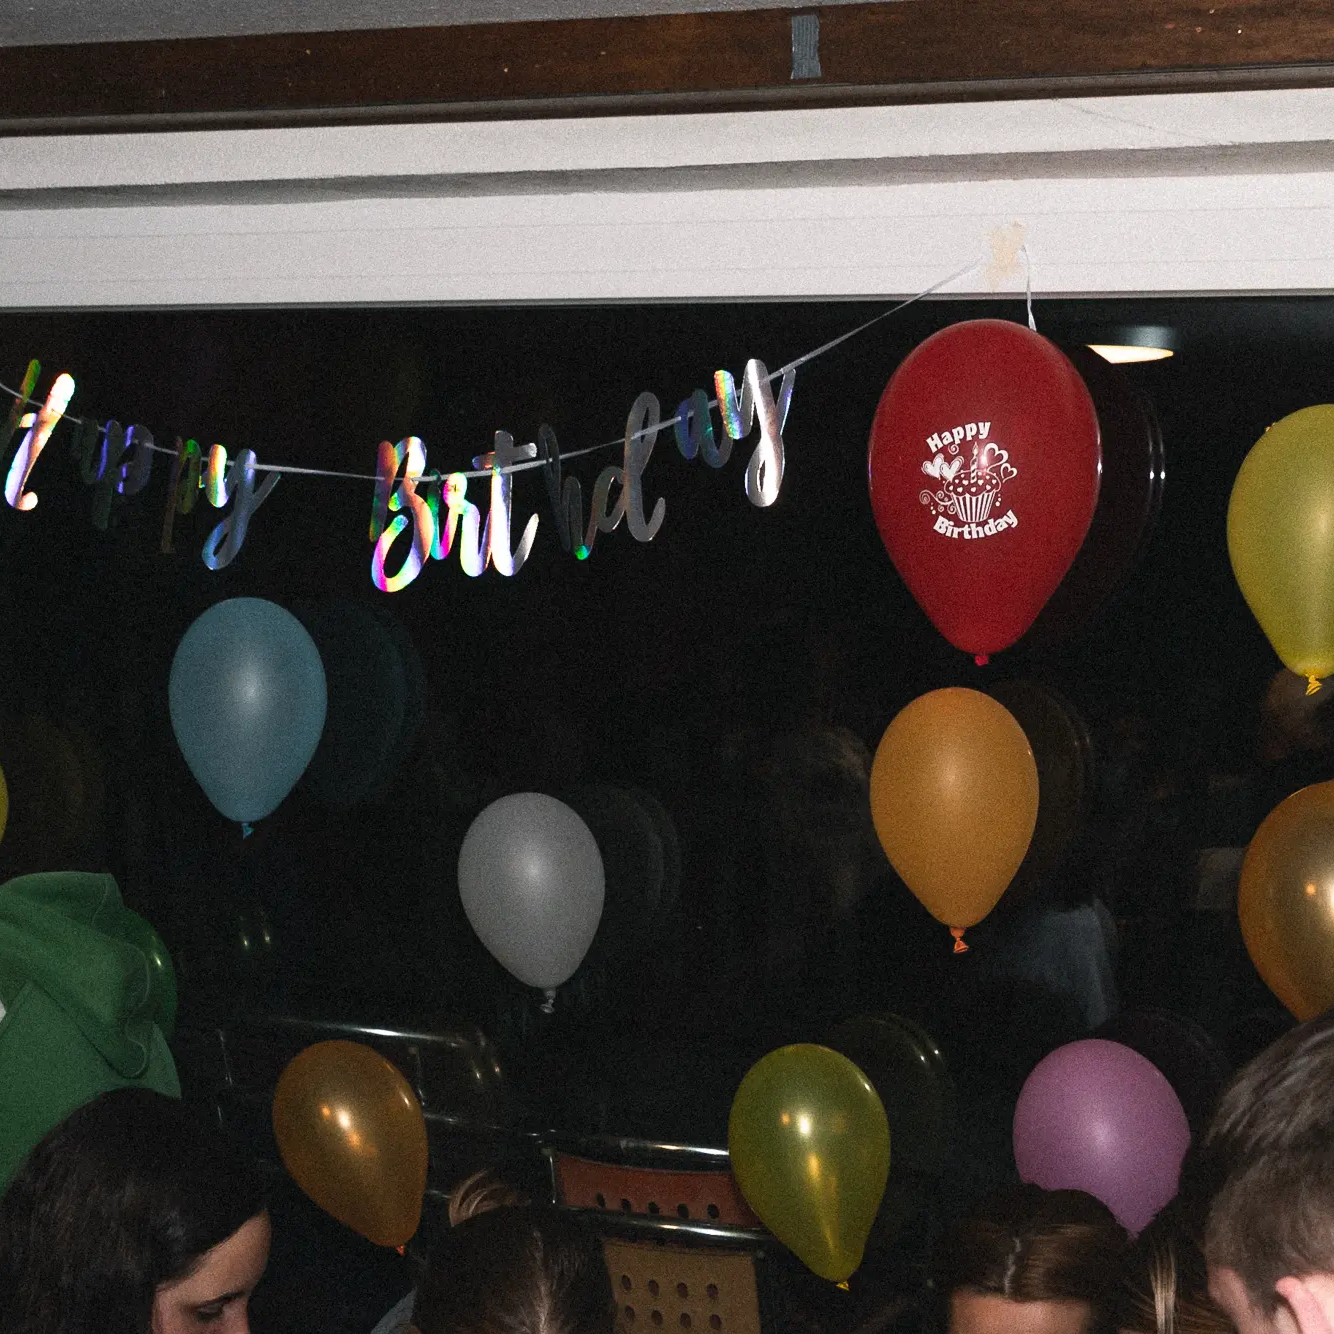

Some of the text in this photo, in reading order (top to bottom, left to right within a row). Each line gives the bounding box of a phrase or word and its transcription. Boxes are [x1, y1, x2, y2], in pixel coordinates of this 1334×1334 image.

[926, 421, 991, 453] Happy
[368, 358, 795, 593] Birthday
[933, 510, 1018, 540] Birthday
